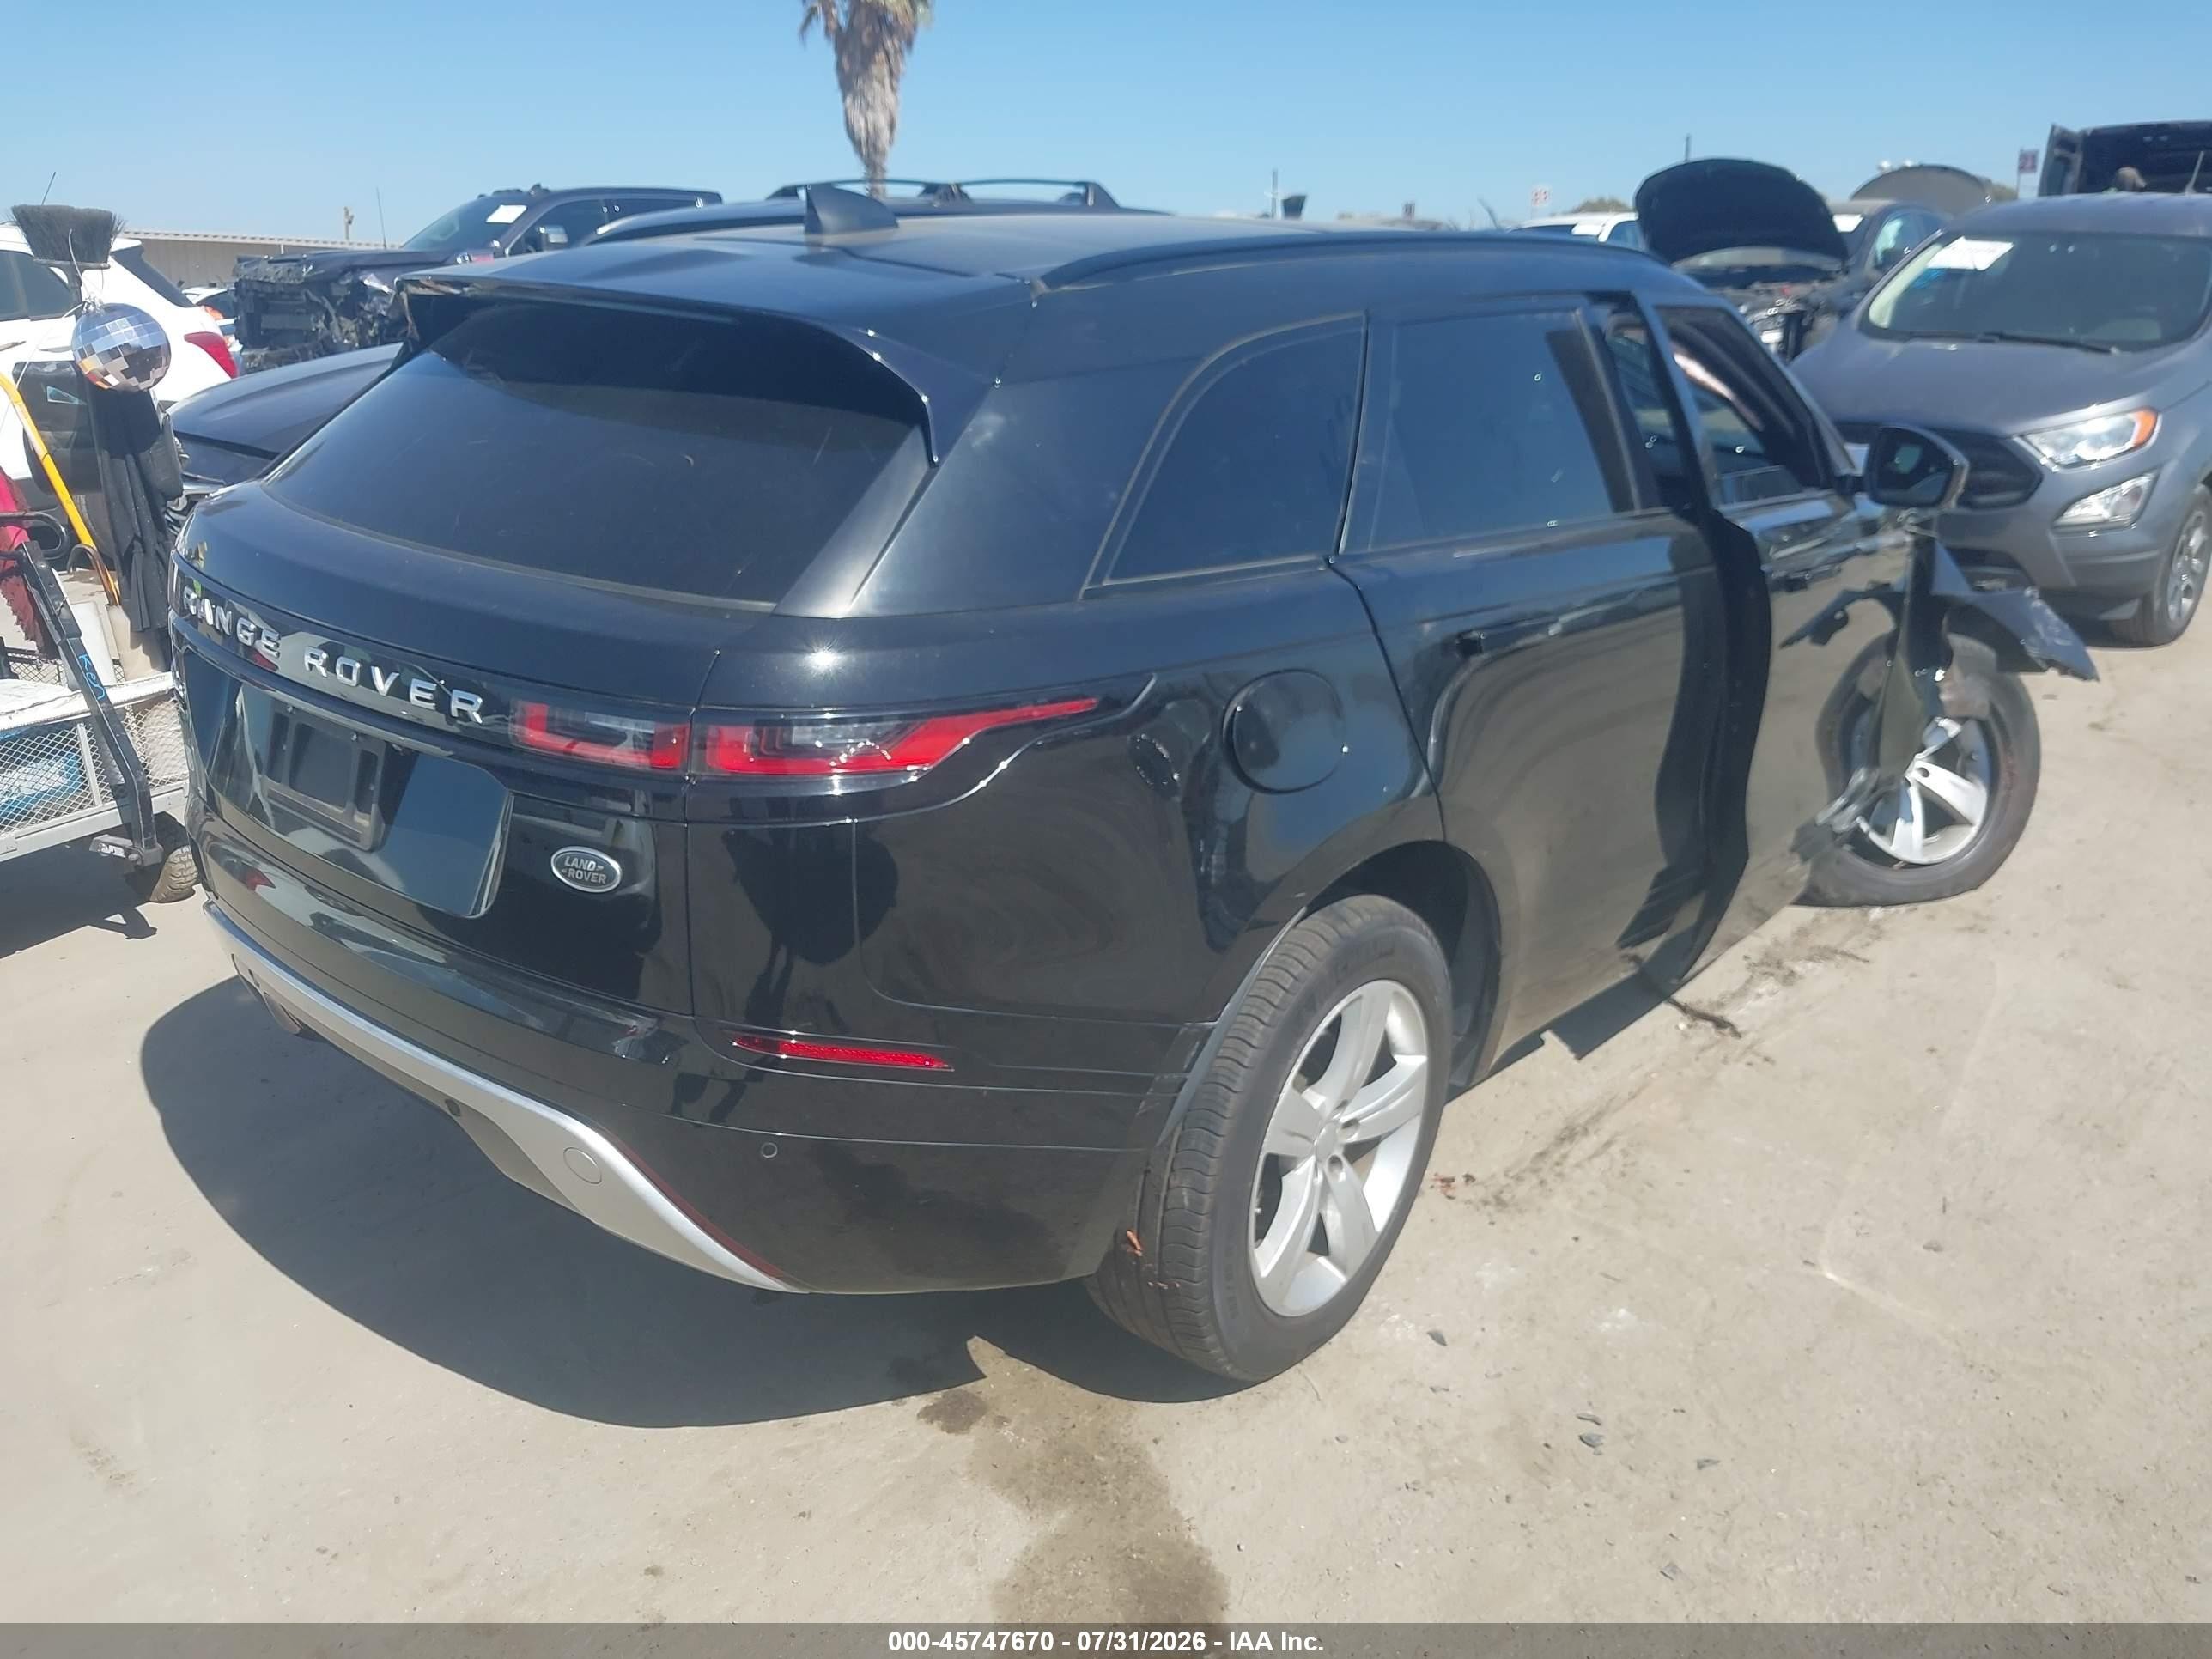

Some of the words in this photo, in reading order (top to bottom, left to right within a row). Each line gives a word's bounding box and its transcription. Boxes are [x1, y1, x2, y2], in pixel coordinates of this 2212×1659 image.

[184, 586, 281, 659] RANGE
[304, 646, 483, 724] ROVER
[564, 855, 597, 872] LAND
[567, 867, 607, 884] ROVER
